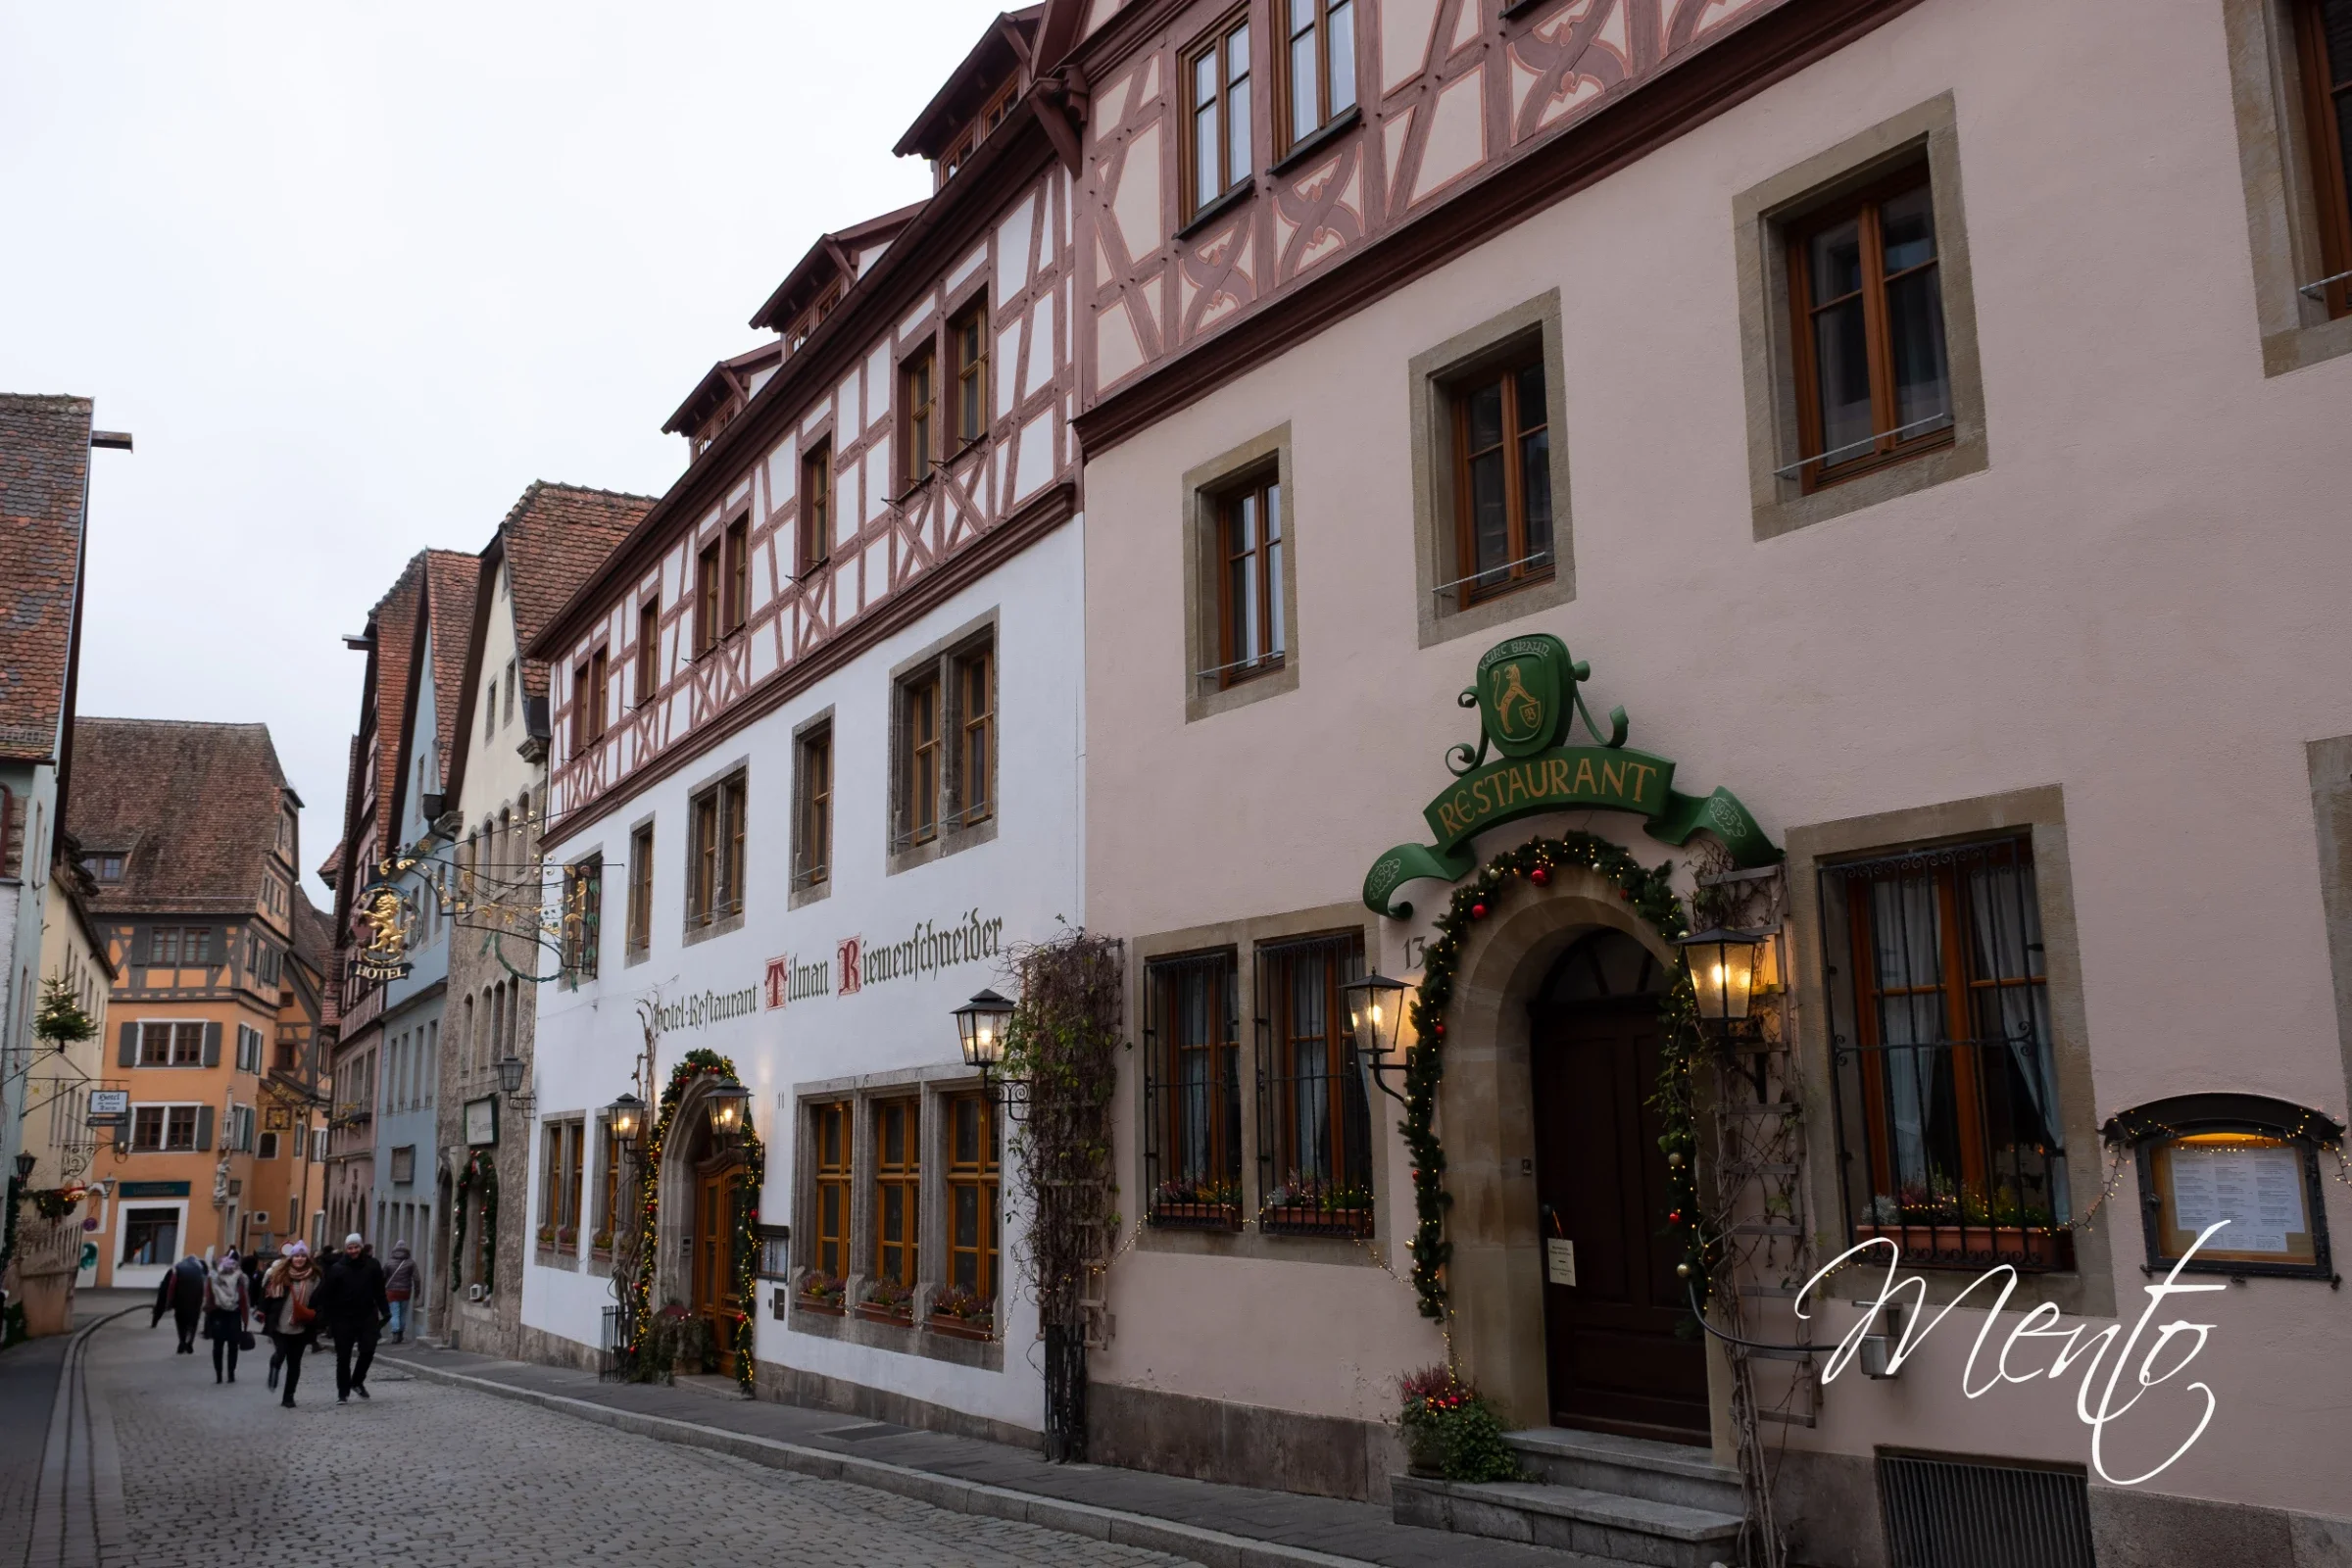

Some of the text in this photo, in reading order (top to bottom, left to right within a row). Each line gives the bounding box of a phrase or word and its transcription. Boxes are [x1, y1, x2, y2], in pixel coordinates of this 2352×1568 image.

[1479, 641, 1549, 671] KURT BRAUN
[1437, 758, 1657, 837] RESTAURANT
[1715, 803, 1737, 826] 1955
[1400, 935, 1427, 970] 13
[355, 963, 408, 980] HOTEL
[764, 952, 830, 1009] Tilman
